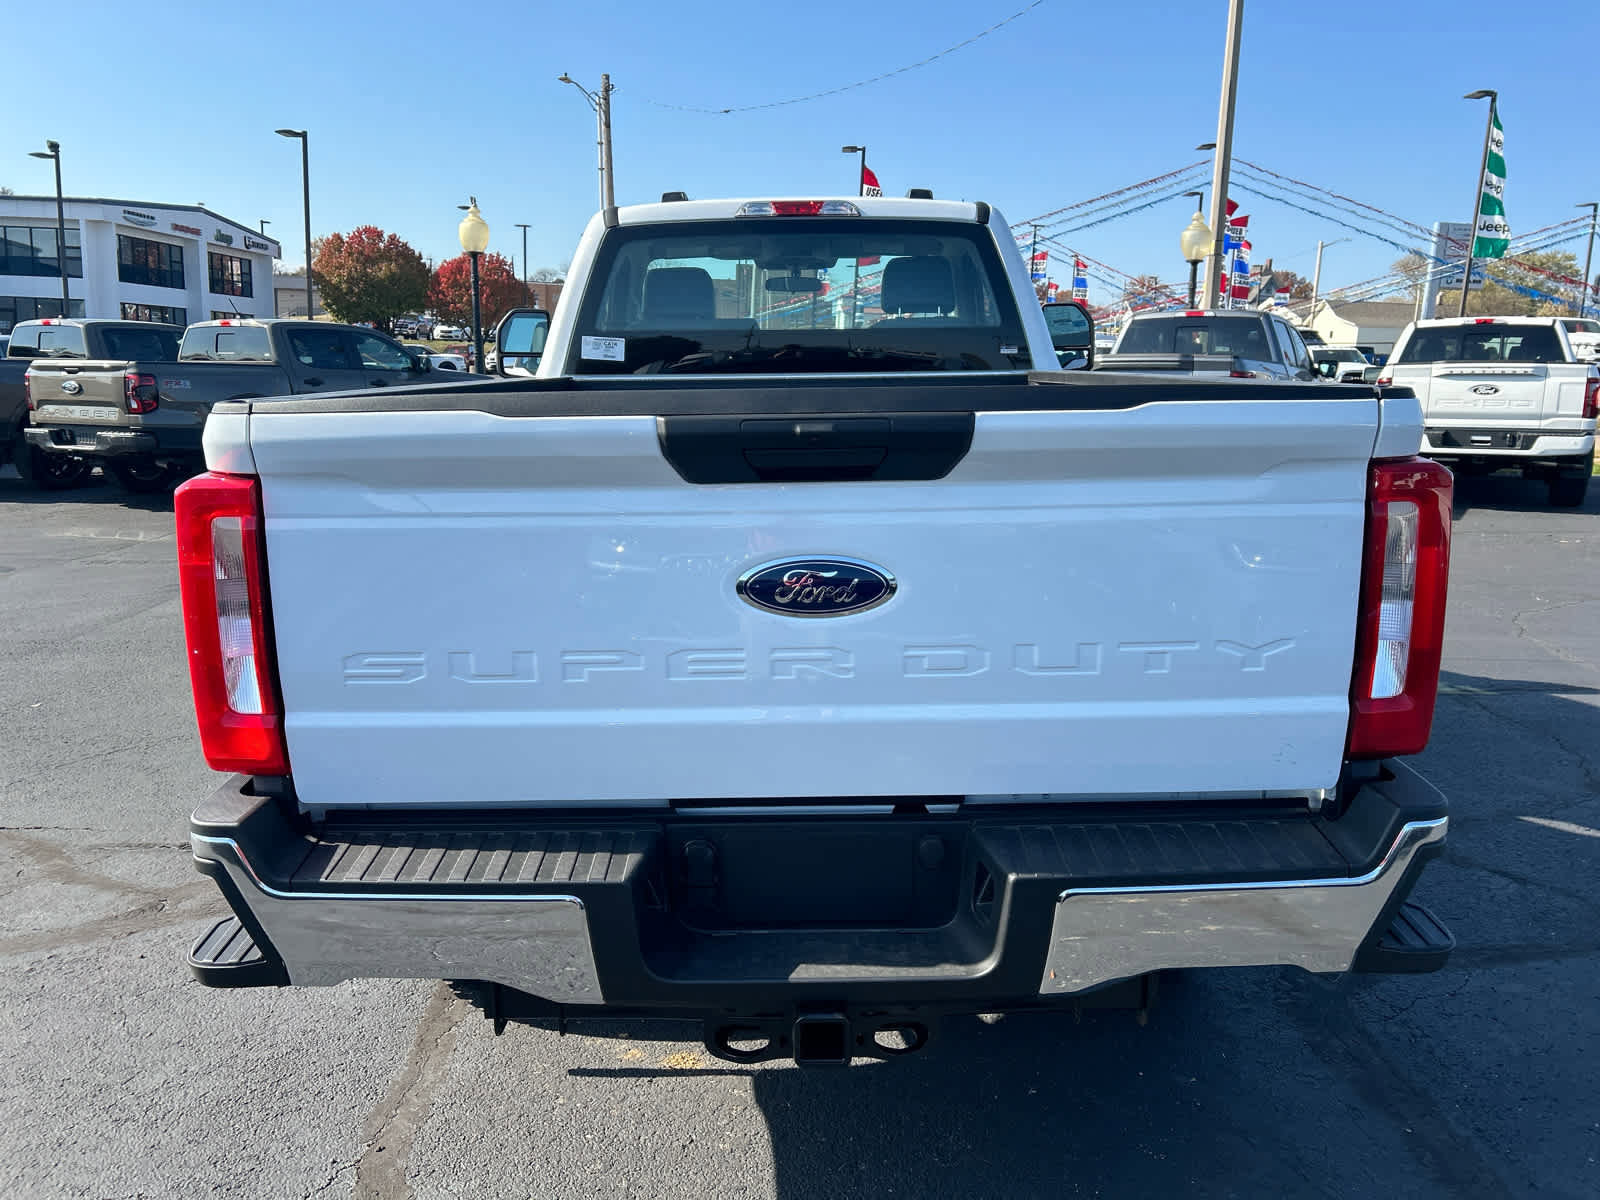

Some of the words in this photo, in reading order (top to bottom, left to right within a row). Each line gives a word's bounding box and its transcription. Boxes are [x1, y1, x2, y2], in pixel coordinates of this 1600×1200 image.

[1479, 220, 1510, 234] Jeep
[774, 569, 859, 604] Ford
[342, 646, 856, 686] SUPER
[902, 637, 1297, 678] DUTY
